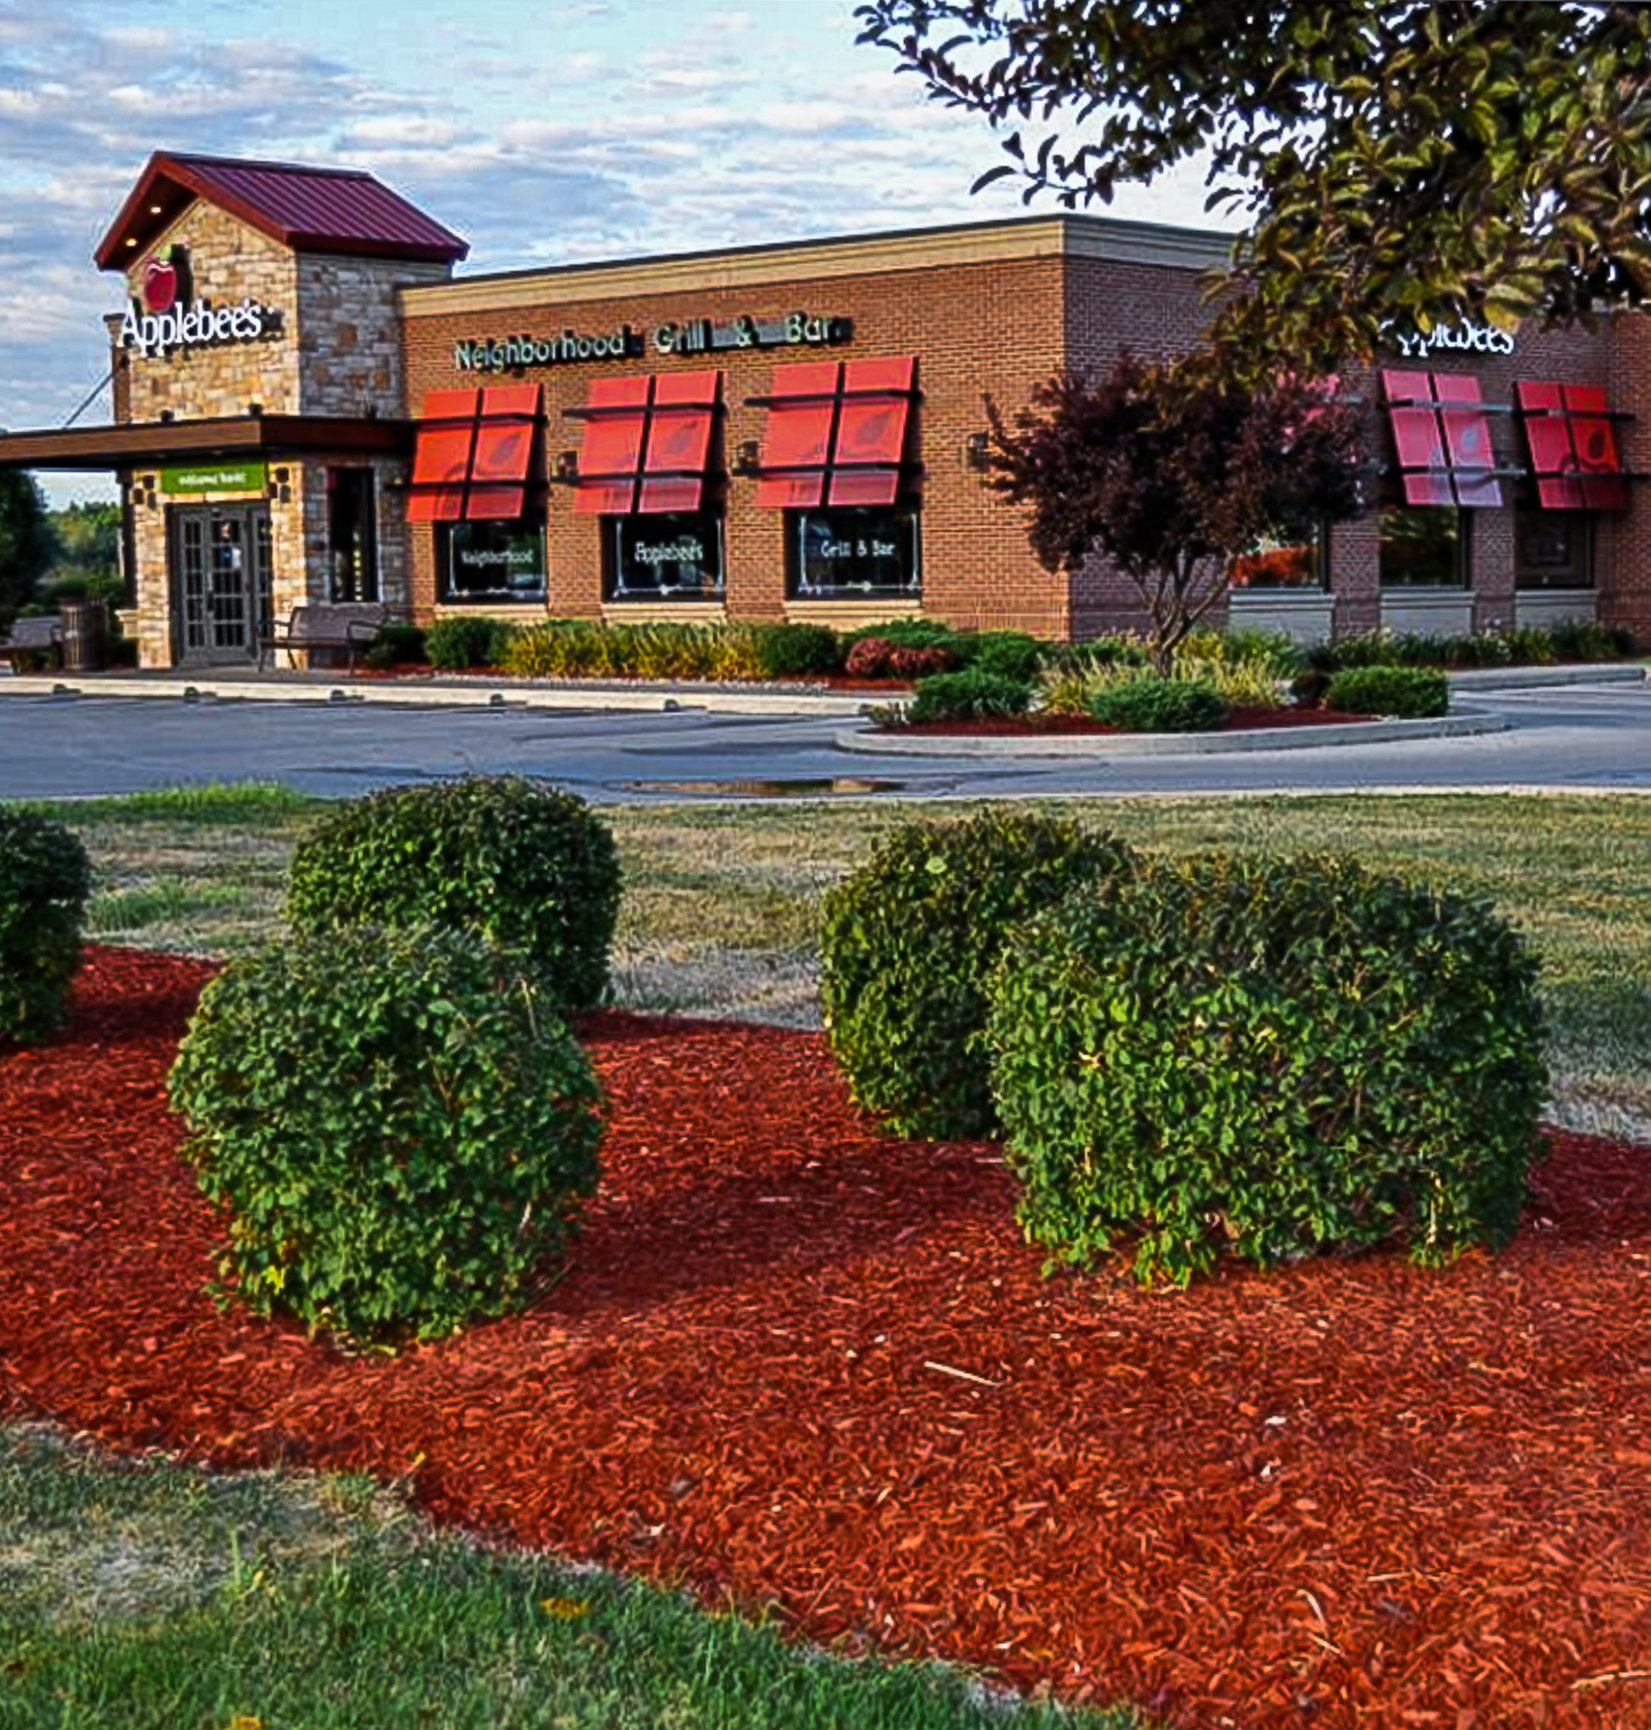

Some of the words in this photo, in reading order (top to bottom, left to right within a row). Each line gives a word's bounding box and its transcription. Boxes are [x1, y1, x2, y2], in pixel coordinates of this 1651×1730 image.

[116, 298, 262, 357] Applebee's
[455, 332, 625, 374] Neighborhood
[655, 318, 705, 354] Grill
[734, 316, 754, 347] &
[786, 313, 834, 344] Bar
[821, 540, 851, 557] Grill
[872, 540, 896, 557] Bar
